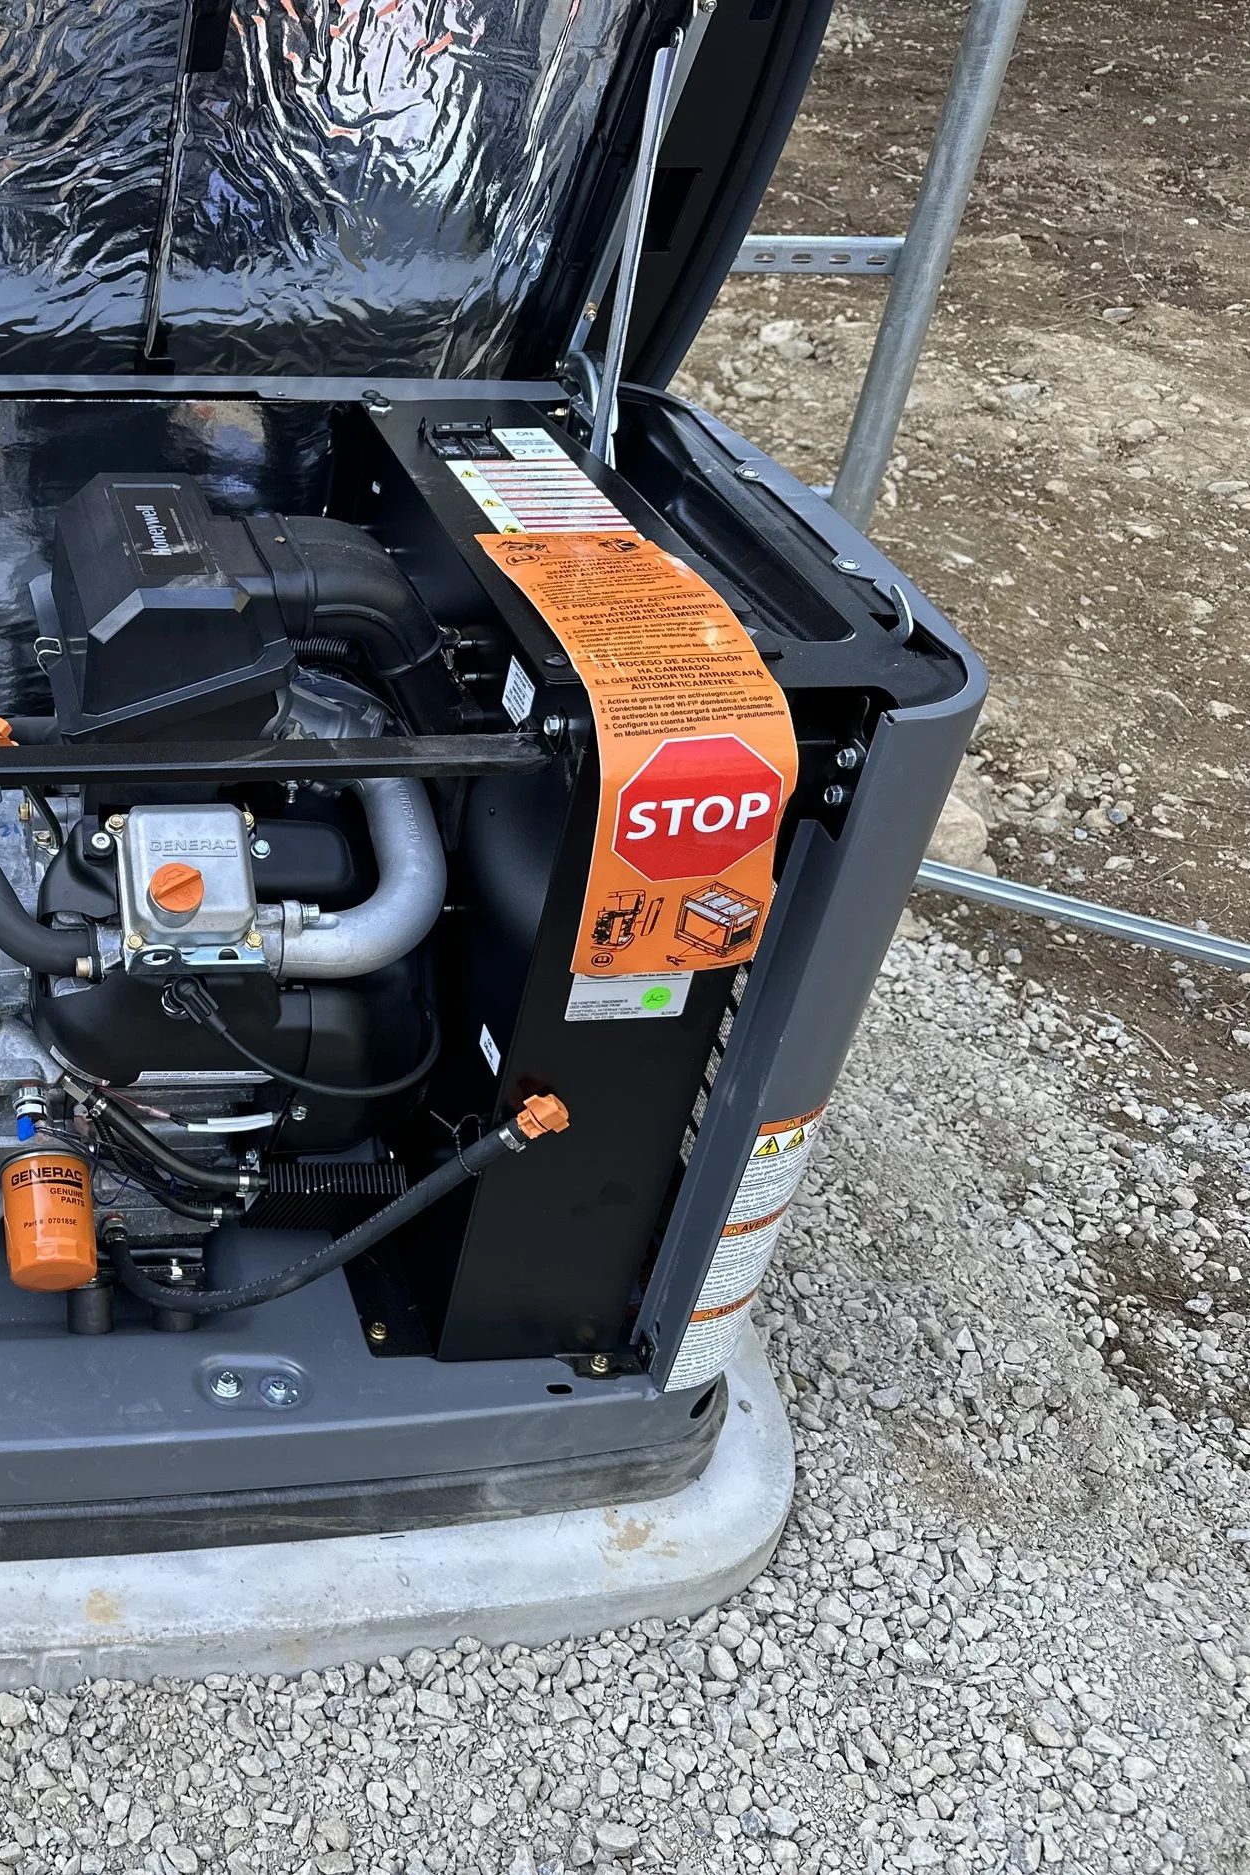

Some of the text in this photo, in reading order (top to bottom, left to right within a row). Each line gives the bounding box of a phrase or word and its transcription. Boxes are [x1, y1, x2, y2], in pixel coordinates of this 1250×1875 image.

[134, 505, 173, 556] Honeywell
[571, 599, 634, 608] PROCESSUS
[648, 592, 706, 602] ACTIVATION
[611, 658, 663, 668] PROCESO
[681, 654, 743, 664] ACTIVACIÓN
[610, 673, 678, 684] GENERADOR
[698, 669, 764, 678] ARRANCARÁ
[609, 704, 647, 713] Conéctese
[748, 695, 773, 703] código
[639, 694, 676, 703] generador
[612, 721, 648, 730] Configure
[660, 717, 685, 725] cuenta
[686, 714, 711, 723] Mobile
[736, 710, 786, 720] gratuitamente
[621, 711, 659, 720] activación
[669, 707, 711, 717] descargará
[624, 725, 697, 737] MobileLinkGen.com
[625, 792, 771, 841] STOP
[150, 838, 238, 852] GENERAC
[11, 1166, 84, 1187] GENERAC
[49, 1187, 84, 1199] GENUINE
[60, 1196, 86, 1208] PARTS
[23, 1219, 38, 1229] Part
[47, 1216, 78, 1226] 070185E
